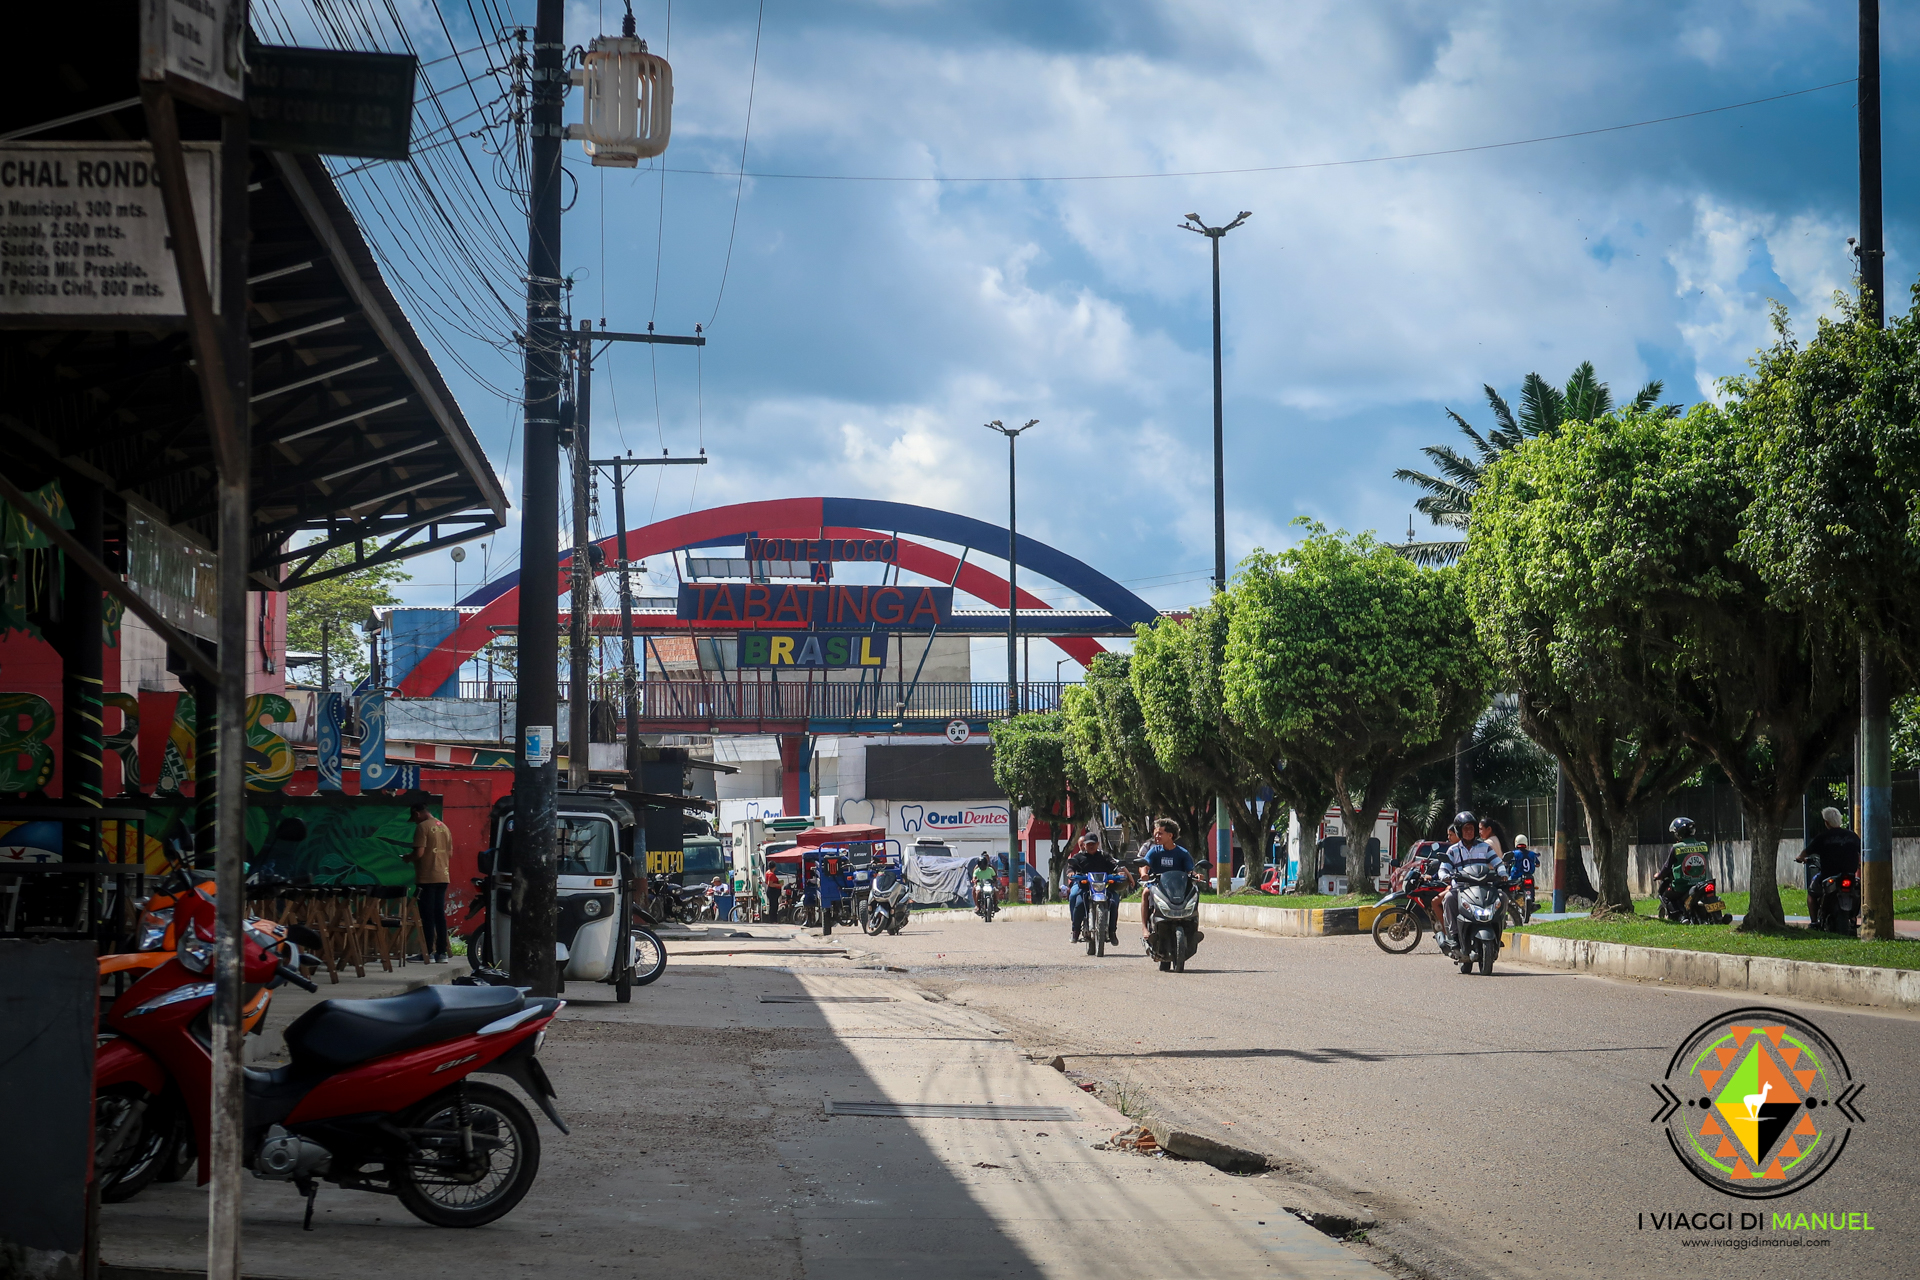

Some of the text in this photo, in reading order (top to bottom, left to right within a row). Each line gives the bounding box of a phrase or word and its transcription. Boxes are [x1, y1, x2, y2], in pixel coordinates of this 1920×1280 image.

[1, 160, 68, 188] CHAL
[8, 200, 82, 221] Municipal,
[86, 200, 112, 217] 300
[116, 202, 147, 218] mts.
[50, 222, 90, 238] 2.500
[94, 223, 126, 239] mts.
[53, 241, 79, 257] 600
[83, 242, 115, 257] mts.
[62, 279, 98, 298] Civil,
[101, 279, 128, 297] 800
[132, 282, 164, 298] mts.
[749, 539, 895, 563] VOLTE LOGO
[814, 564, 827, 583] A
[688, 583, 941, 625] TABATINGA
[744, 635, 882, 665] BRASIL
[950, 727, 956, 735] 6
[646, 850, 683, 874] MENTO
[1523, 859, 1530, 872] 9
